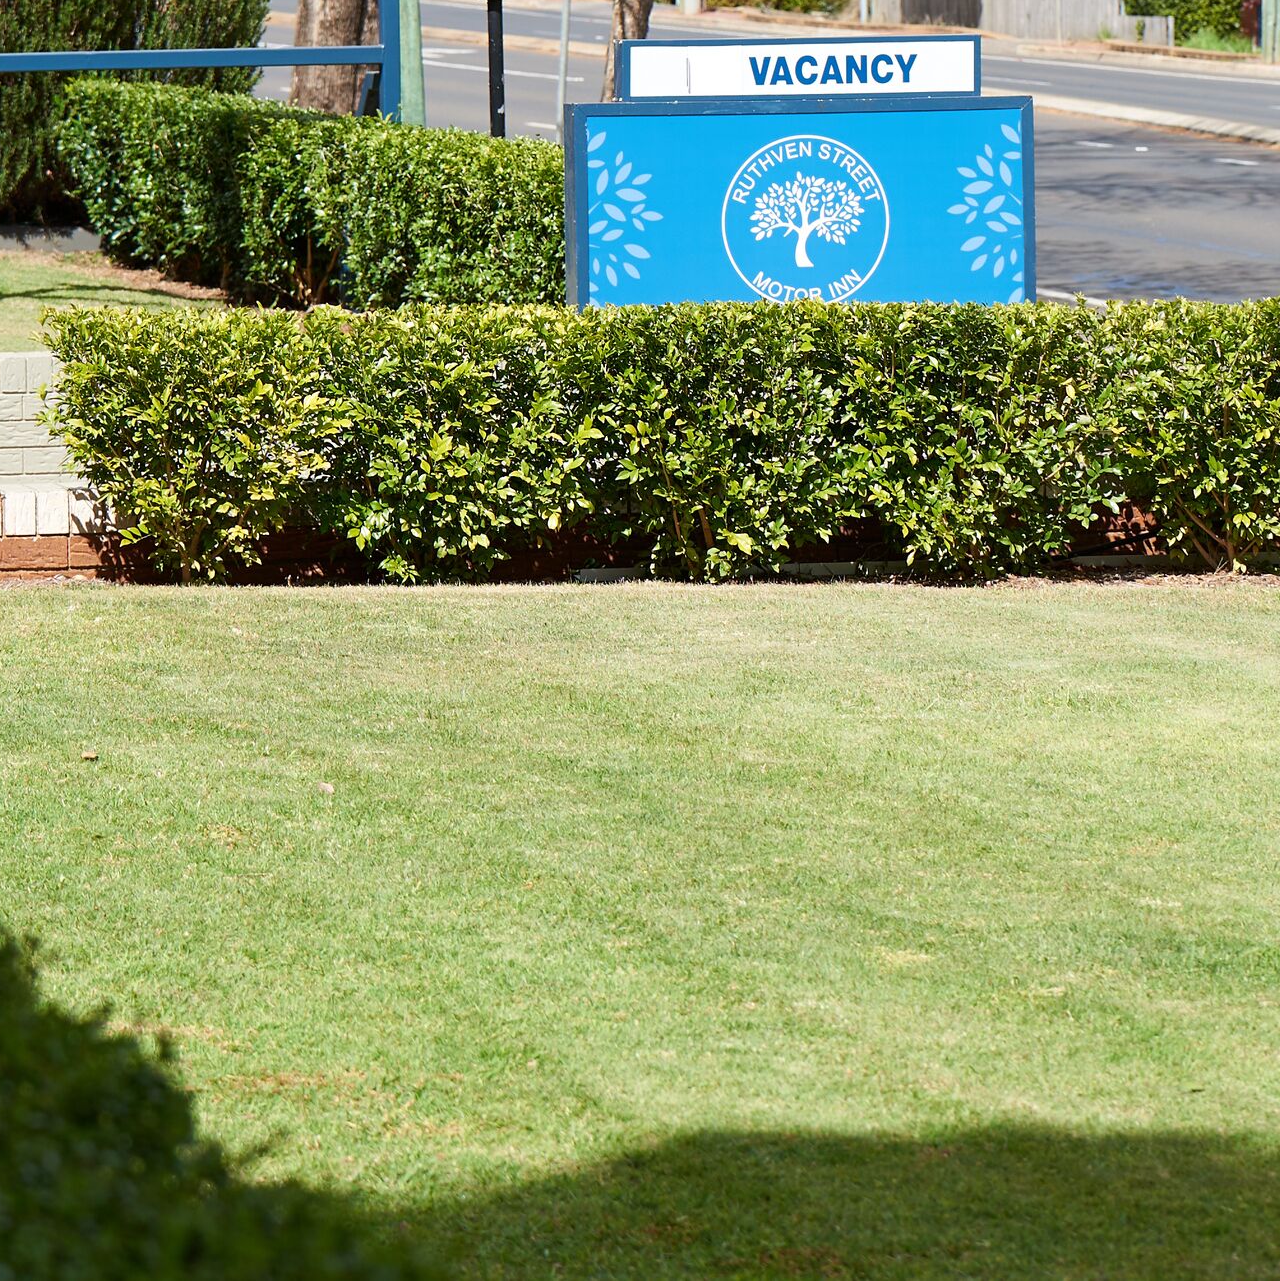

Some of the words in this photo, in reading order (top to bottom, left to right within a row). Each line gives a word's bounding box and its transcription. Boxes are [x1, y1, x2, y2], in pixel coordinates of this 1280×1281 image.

[749, 53, 918, 86] VACANCY
[732, 141, 813, 204] RUTHVEN
[818, 143, 881, 202] STREET
[752, 271, 822, 302] MOTOR
[828, 269, 862, 299] INN
